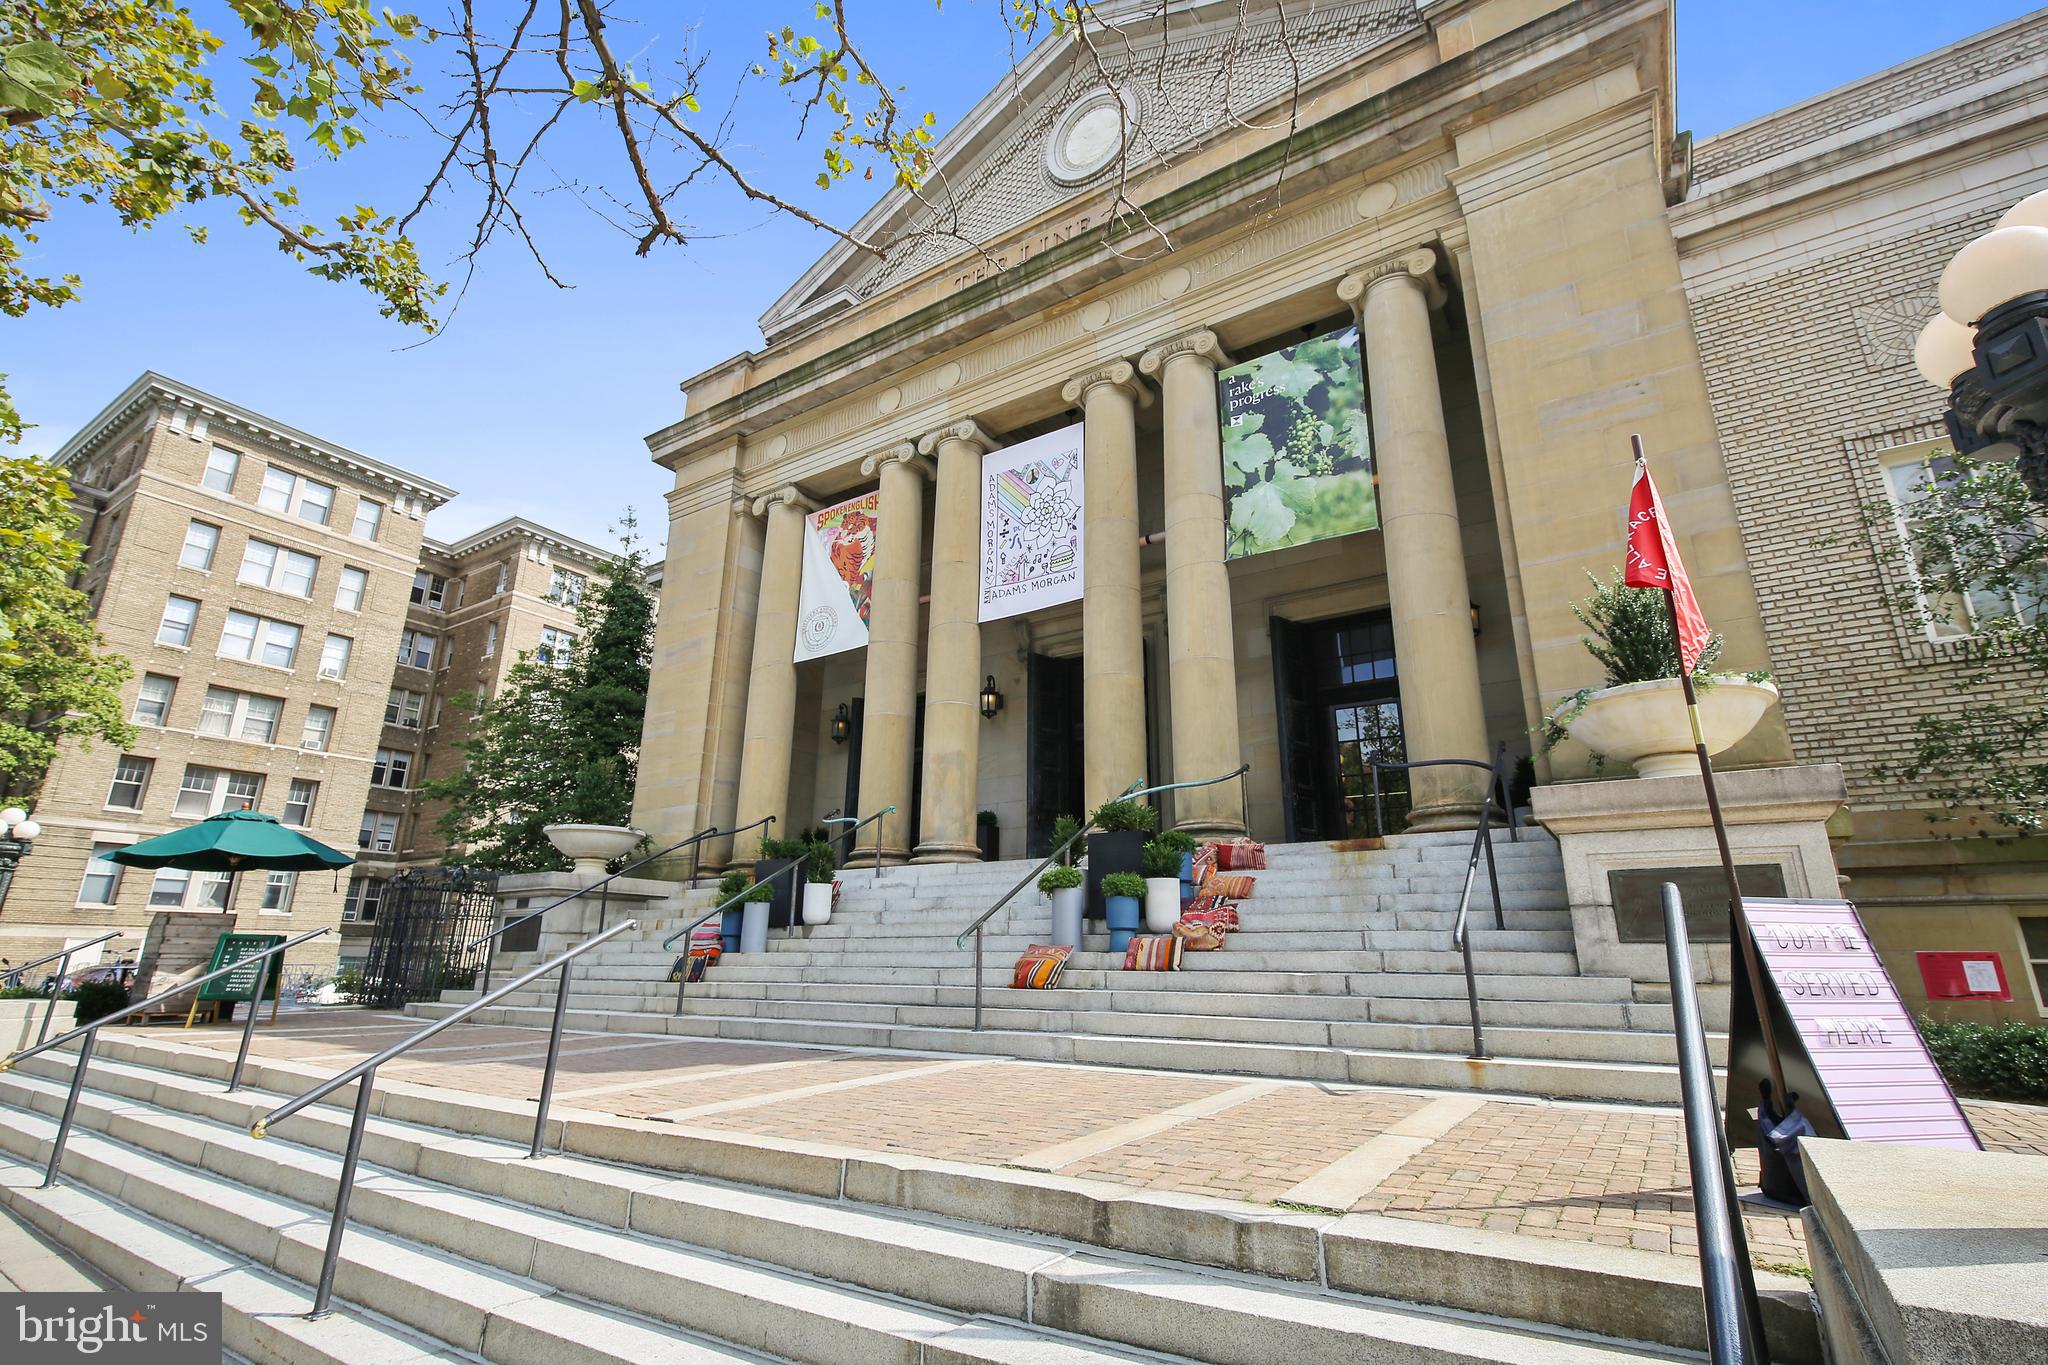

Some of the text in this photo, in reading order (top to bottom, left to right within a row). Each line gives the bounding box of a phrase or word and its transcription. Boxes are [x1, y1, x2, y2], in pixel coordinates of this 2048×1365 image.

[1228, 375, 1236, 385] a
[1229, 377, 1265, 397] rake's
[1229, 383, 1287, 412] progress
[985, 474, 997, 575] ADAMS MORGAN
[991, 583, 1027, 601] ADAMS
[1031, 570, 1077, 592] MORGAN
[1786, 971, 1880, 997] SERVED
[1818, 1019, 1893, 1046] HERE
